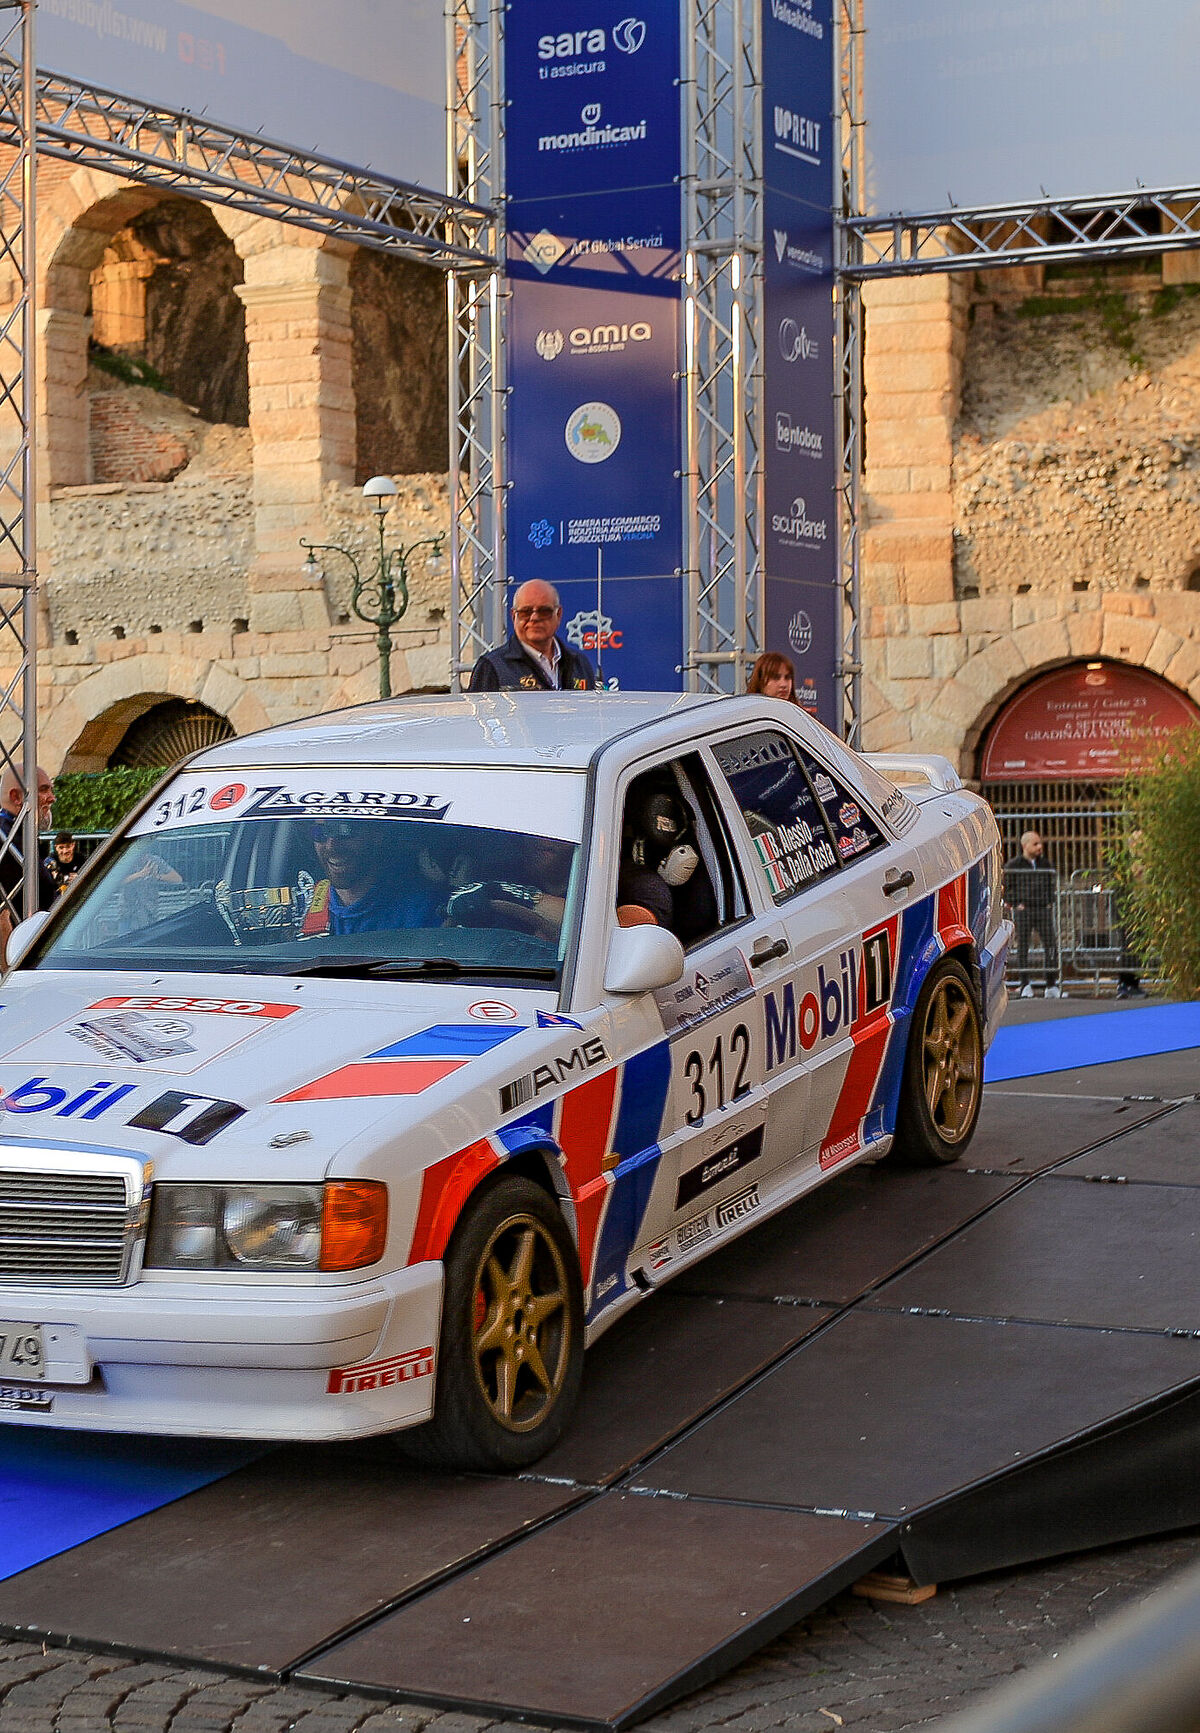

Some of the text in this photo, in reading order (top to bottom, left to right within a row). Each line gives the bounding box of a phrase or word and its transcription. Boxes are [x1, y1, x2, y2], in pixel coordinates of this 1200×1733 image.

[538, 29, 605, 59] sara
[539, 61, 606, 79] ti assicura
[538, 120, 646, 151] mondinicavi
[591, 238, 624, 254] Global
[627, 233, 663, 251] Servizi
[569, 322, 652, 346] amia
[777, 420, 823, 450] bentobox
[568, 515, 660, 529] CAMERA DI COMMERCIO
[568, 525, 609, 536] INDUSTRIA
[568, 533, 622, 544] AGRICOLTURA
[582, 631, 623, 650] SEC
[1046, 701, 1089, 711] Entrata
[155, 786, 208, 827] 312
[246, 785, 448, 808] ZAGARDI
[301, 807, 389, 816] RACING
[777, 816, 813, 854] Alessio
[808, 839, 837, 873] Costa
[116, 998, 266, 1013] ESSO
[763, 947, 858, 1072] Mobil
[533, 1036, 609, 1096] AMG
[684, 1022, 753, 1129] 312
[716, 1181, 760, 1229] PIRELLI
[326, 1346, 434, 1394] PIRELLI
